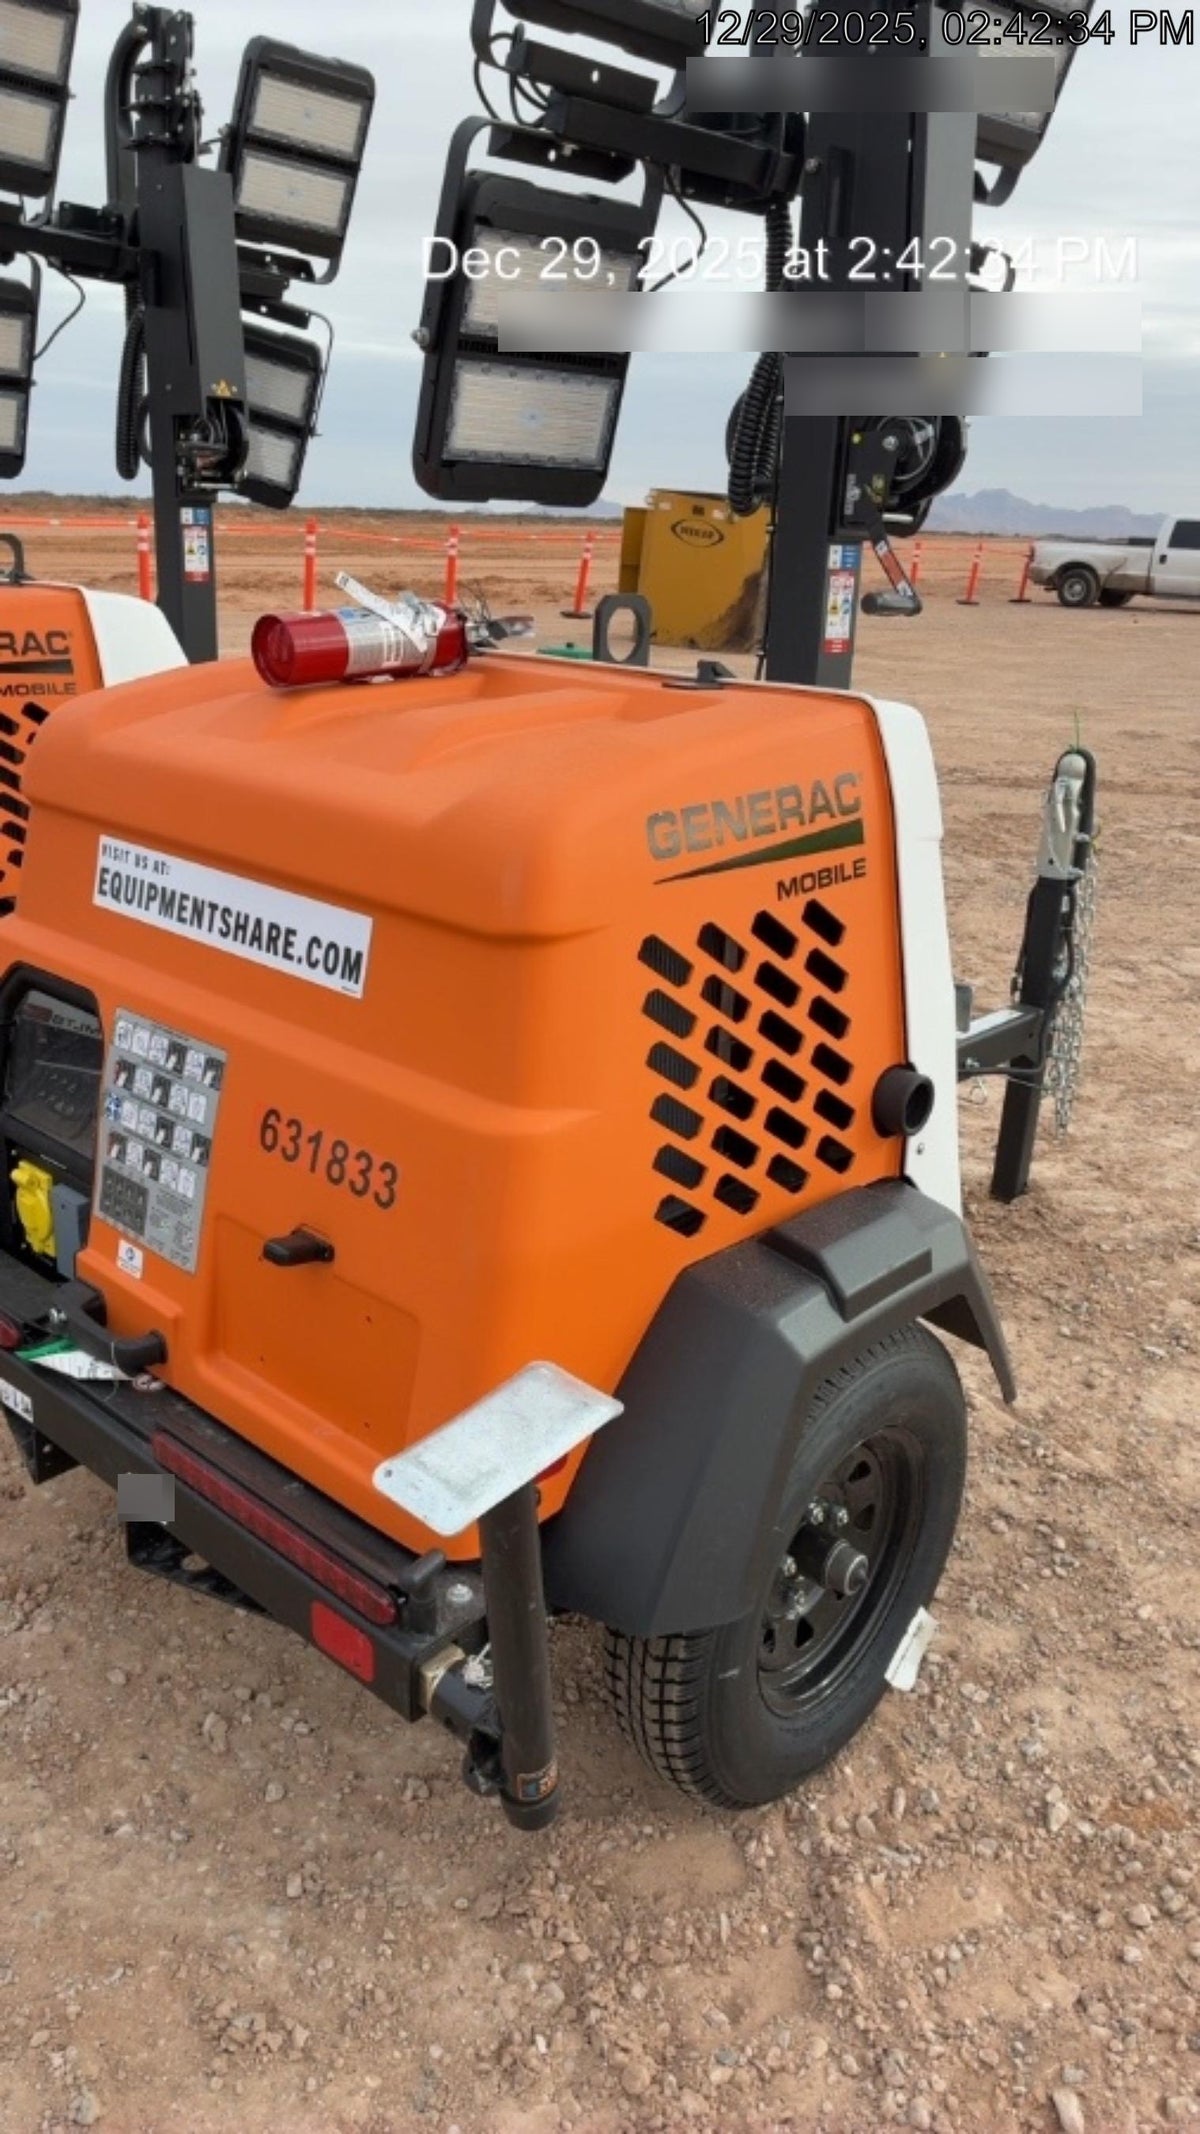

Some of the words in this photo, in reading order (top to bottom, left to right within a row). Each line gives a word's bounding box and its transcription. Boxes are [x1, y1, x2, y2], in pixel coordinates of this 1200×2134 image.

[101, 843, 131, 864] VISIT
[134, 854, 148, 870] US
[645, 772, 862, 861] GENERAC
[776, 857, 867, 901] MOBILE
[97, 866, 364, 985] EQUIPMENTSHARE.COM
[260, 1108, 398, 1210] 631833
